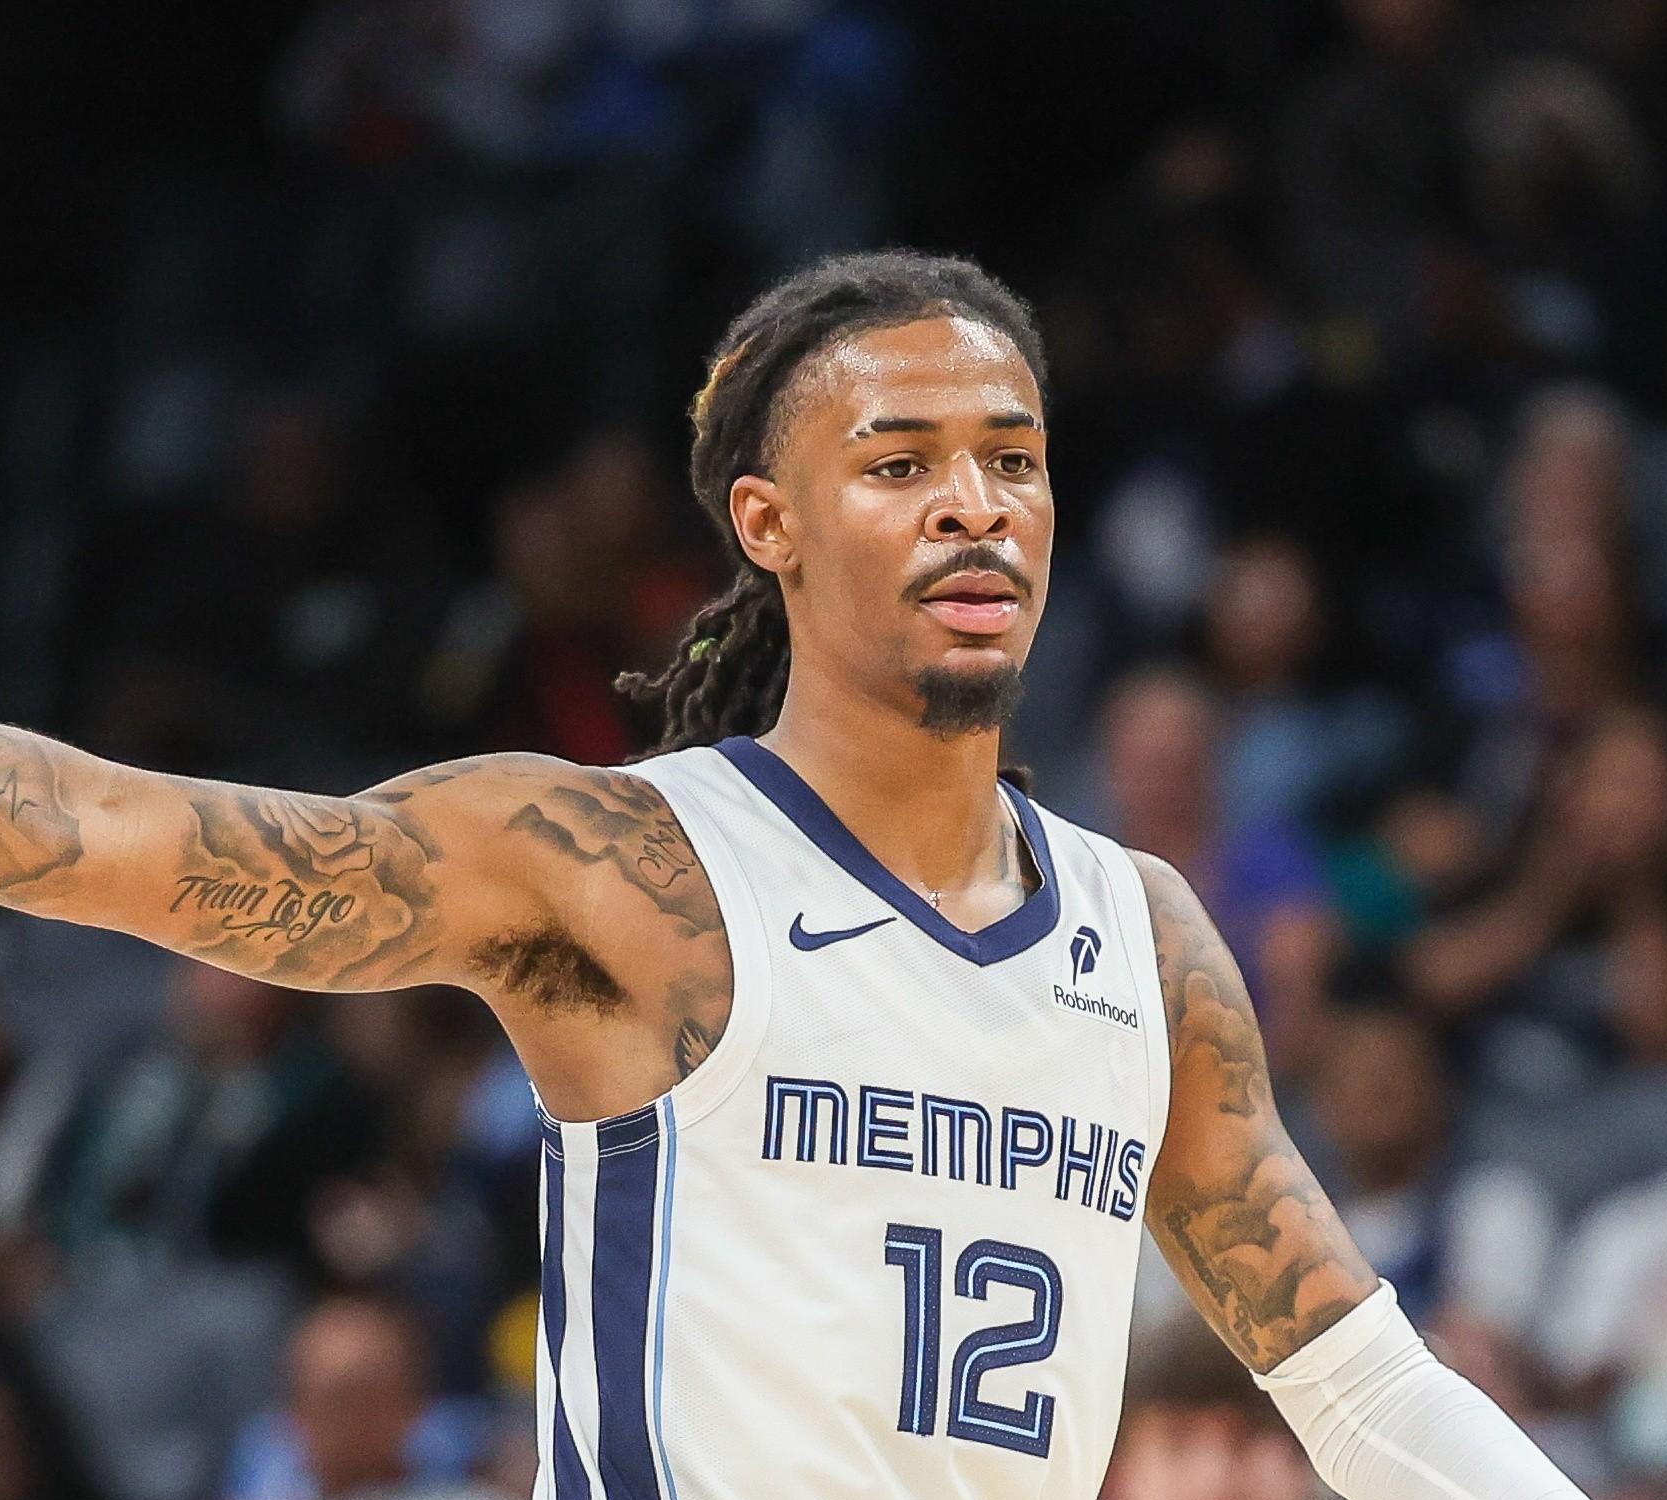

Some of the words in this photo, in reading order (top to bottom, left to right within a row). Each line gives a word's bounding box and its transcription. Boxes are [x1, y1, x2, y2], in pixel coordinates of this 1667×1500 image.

[1053, 984, 1138, 1029] Robinhood
[761, 1075, 1146, 1223] MEMPHIS
[884, 1222, 1064, 1459] 12
